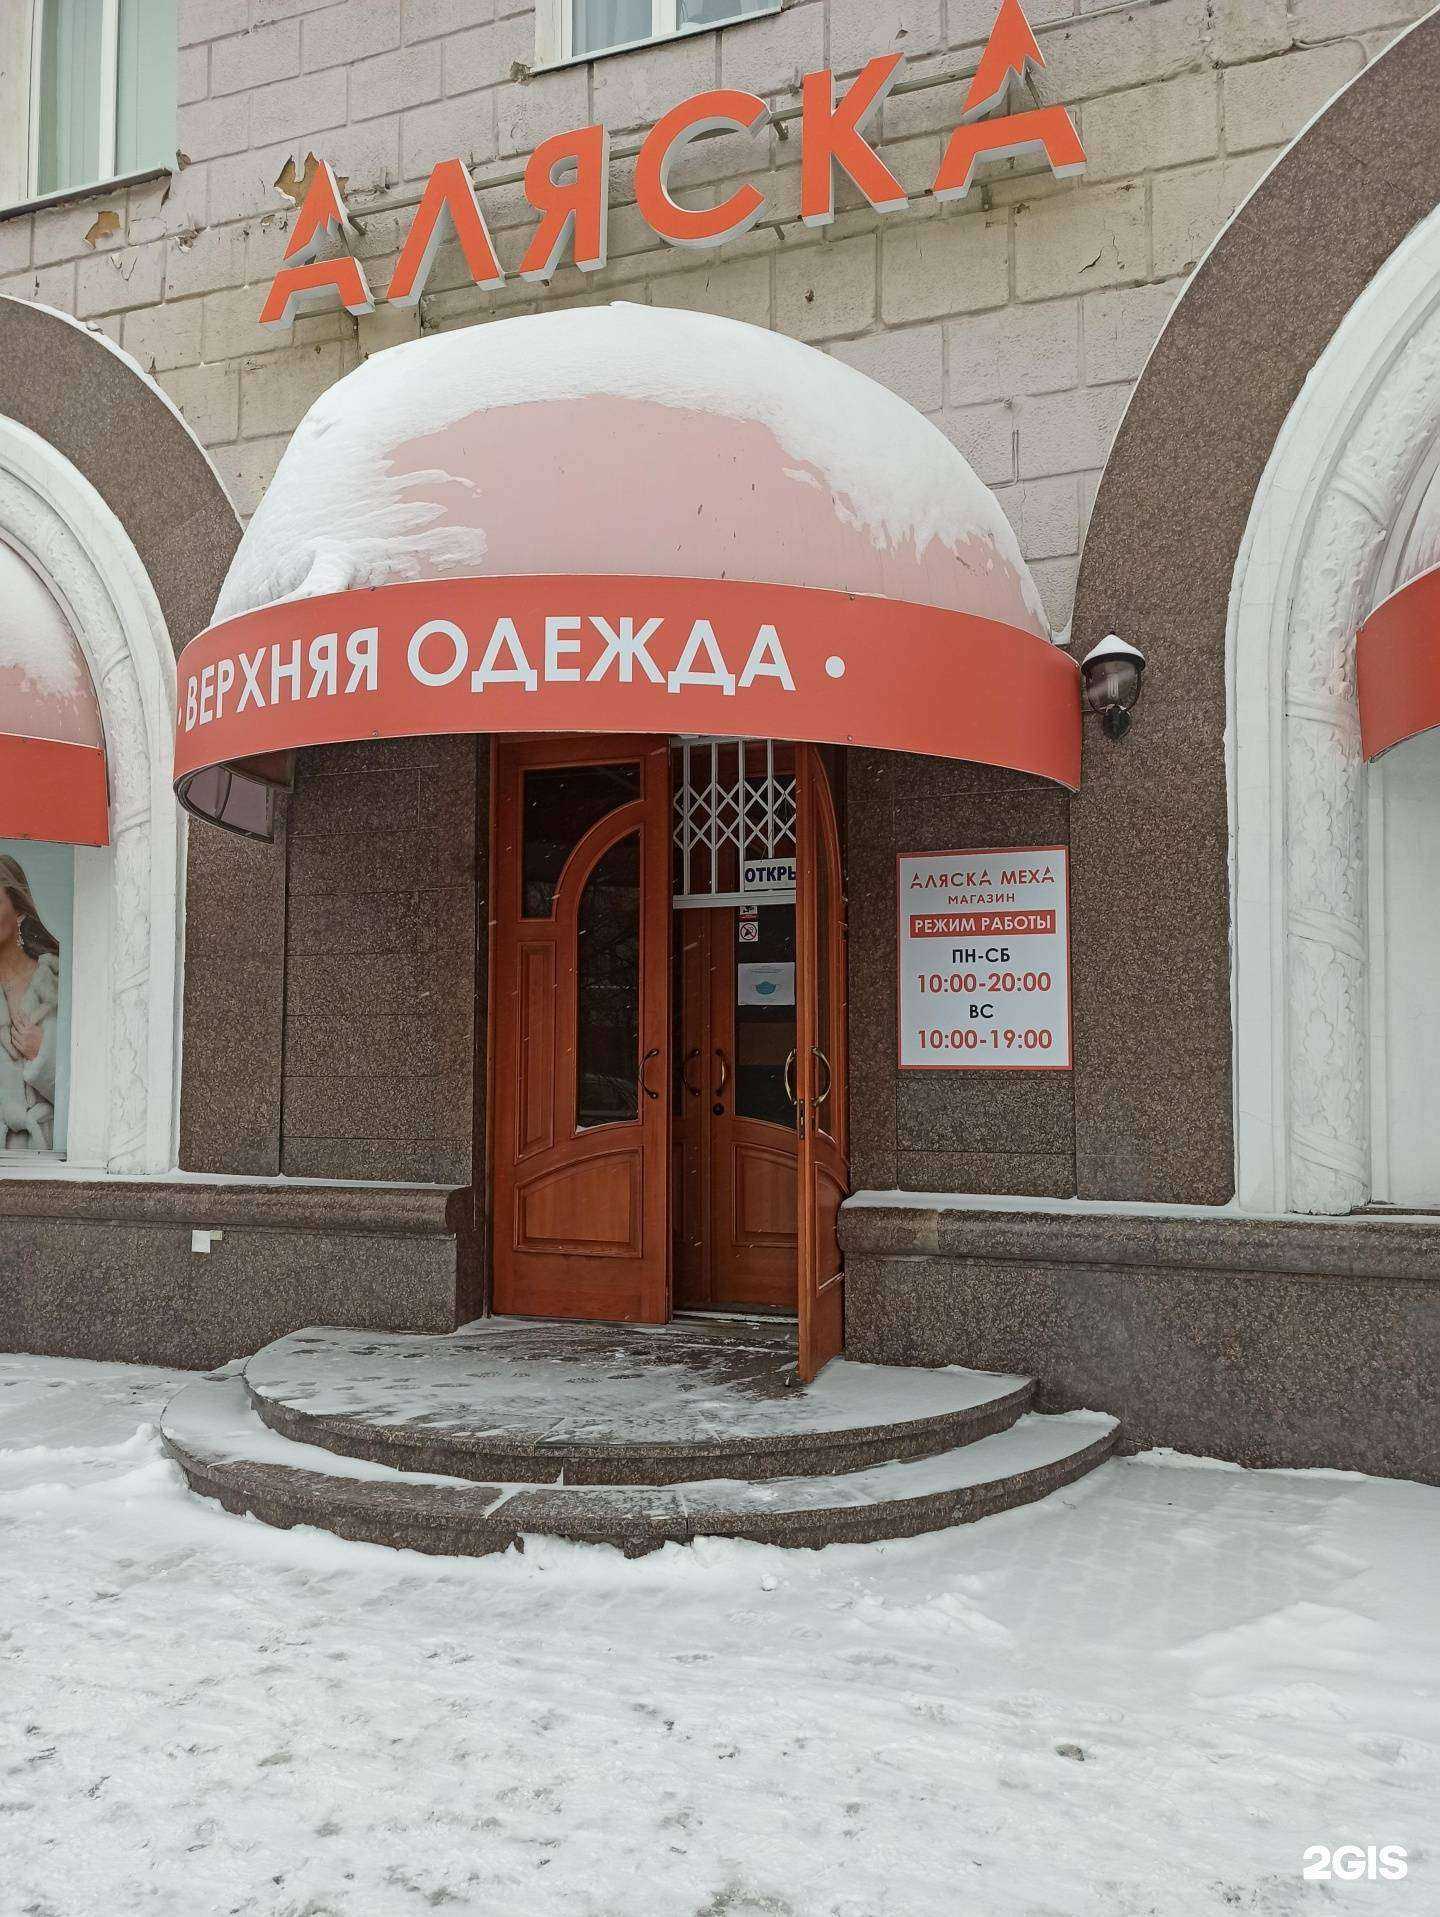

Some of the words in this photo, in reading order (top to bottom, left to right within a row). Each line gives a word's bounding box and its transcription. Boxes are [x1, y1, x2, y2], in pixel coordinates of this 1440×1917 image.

[258, 0, 1087, 331] АЛЯСКА
[185, 627, 379, 733] ВЕРХНЯЯ
[407, 616, 796, 696] ОДЕЖДА
[910, 869, 993, 889] АЛЯСКА
[1000, 866, 1055, 885] МЕХА
[948, 892, 1016, 905] МАГАЗИН
[914, 918, 977, 934] РЕЖИМ
[981, 915, 1051, 932] РАБОТЫ
[952, 948, 1011, 964] ПН-СБ
[918, 972, 1052, 993] 10:00-20:00
[968, 1004, 994, 1019] ВС
[918, 1029, 1053, 1049] 10:00-19:00
